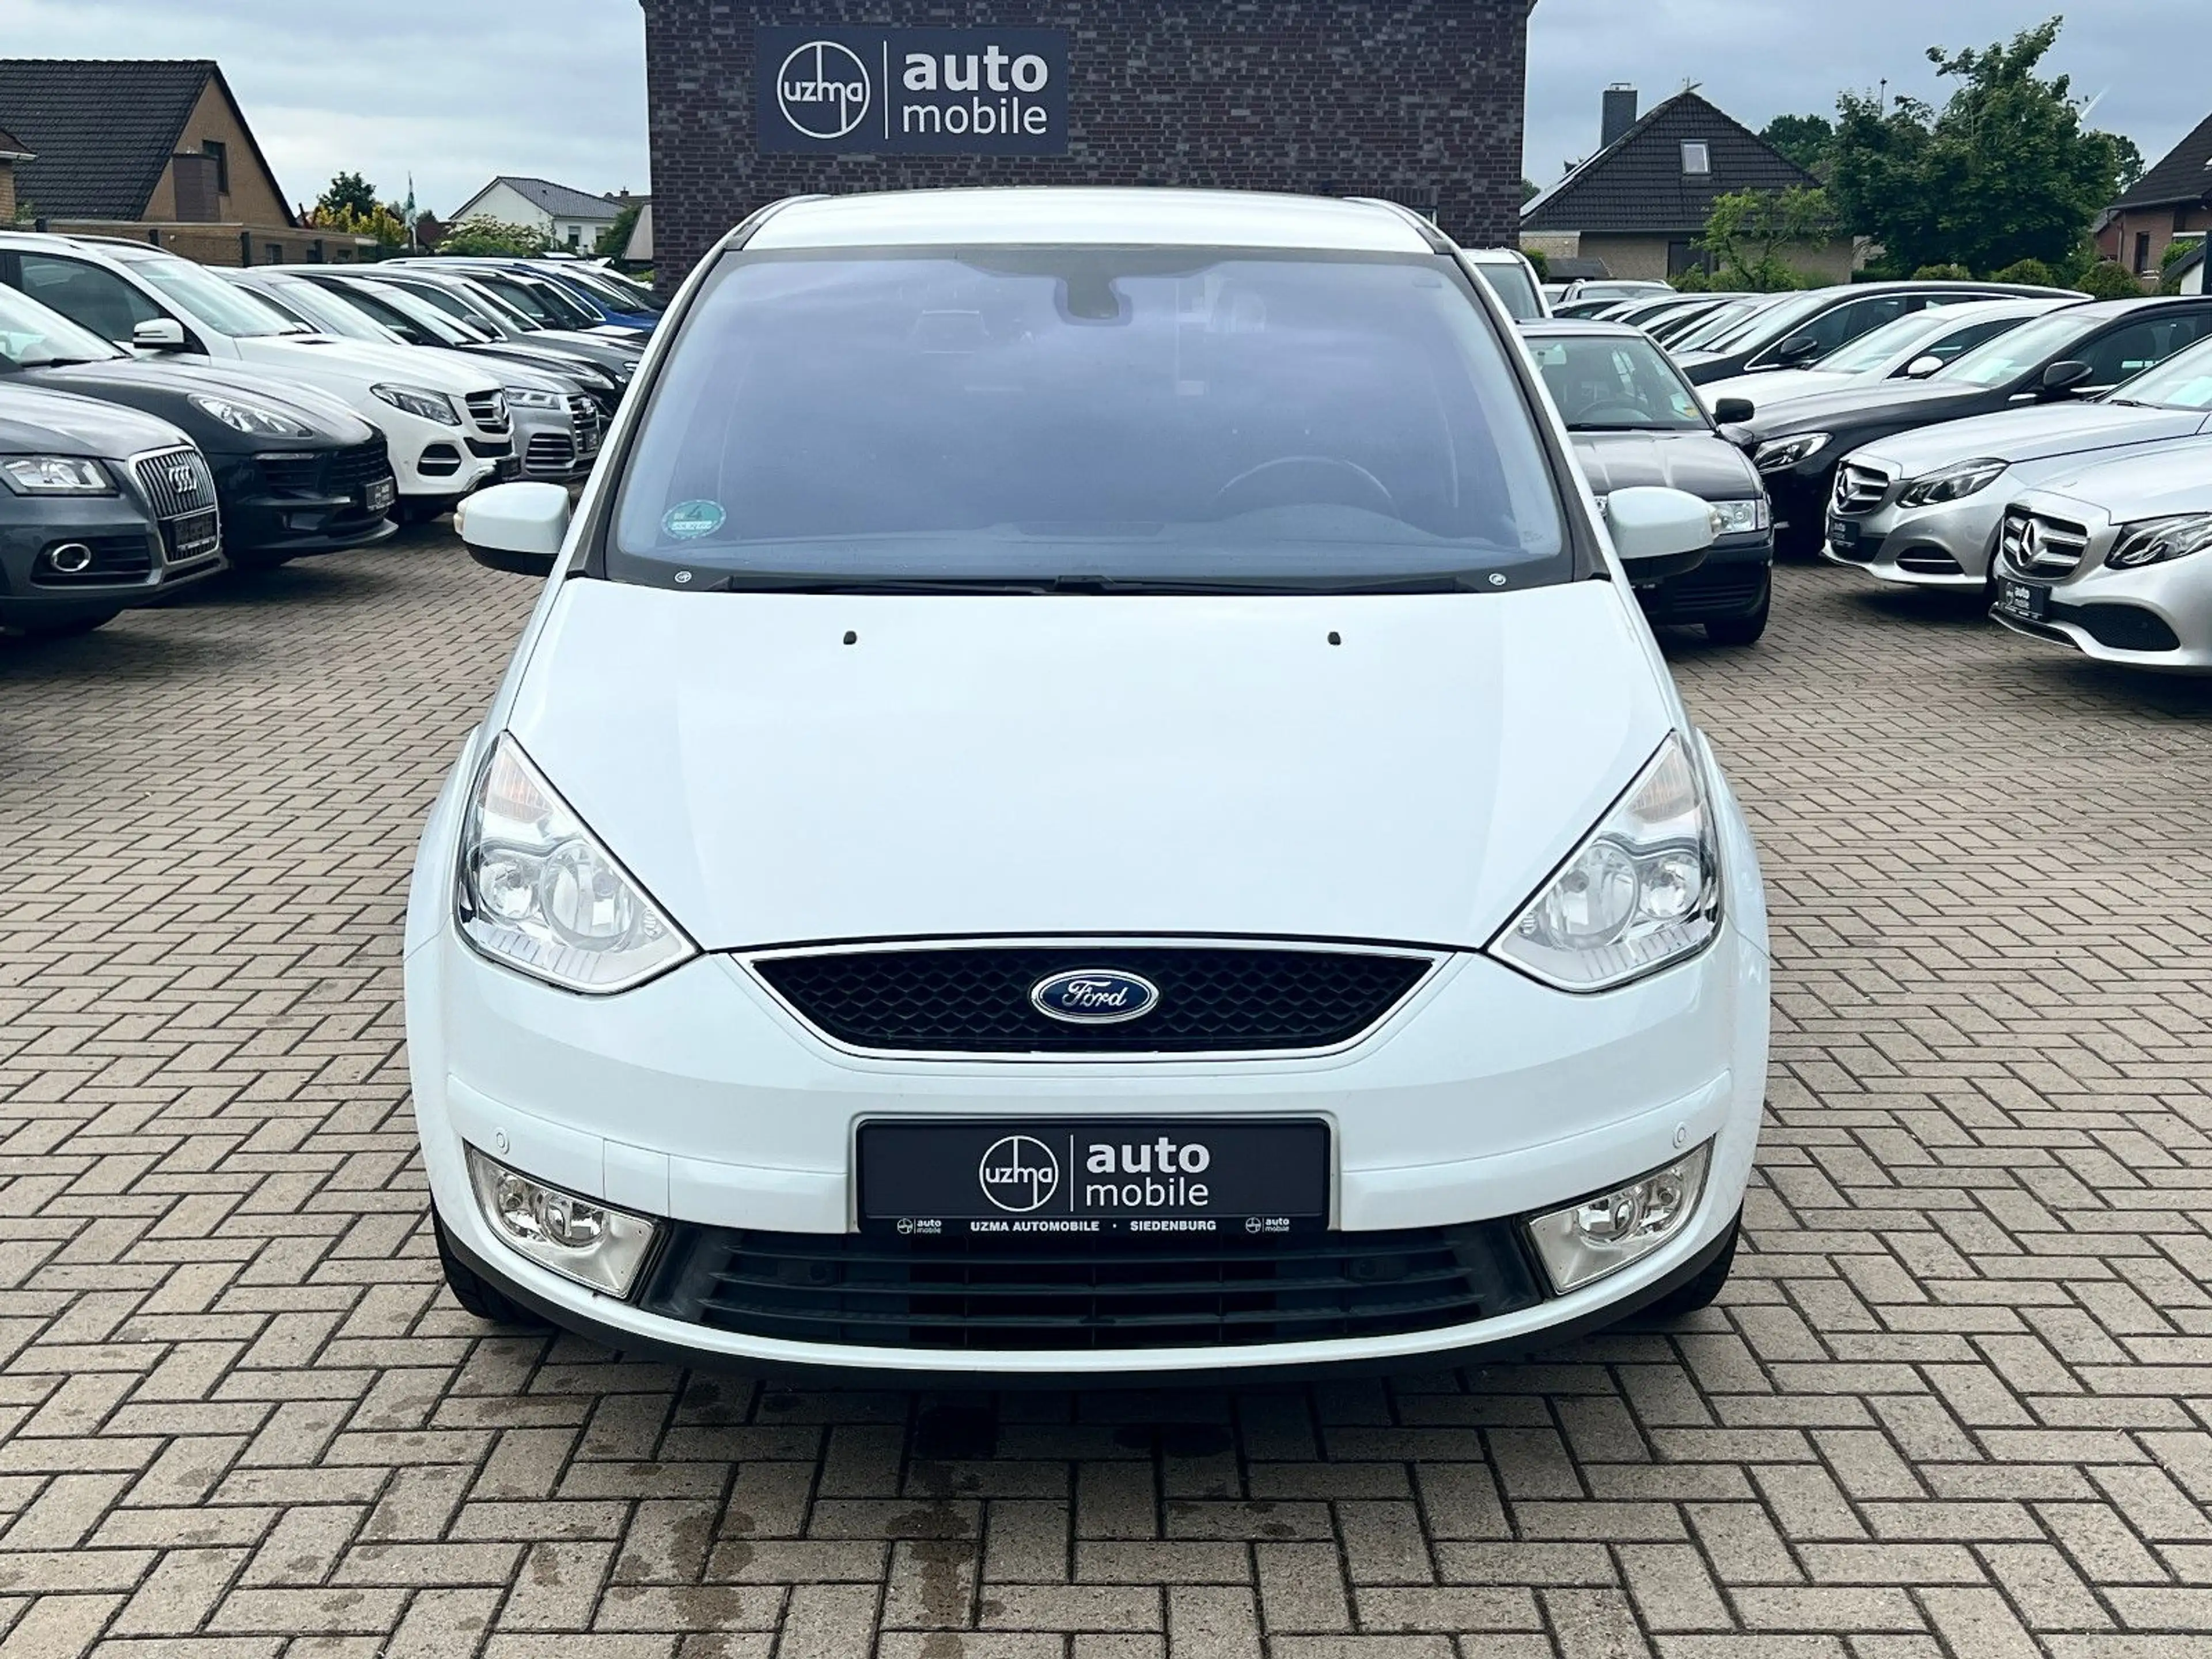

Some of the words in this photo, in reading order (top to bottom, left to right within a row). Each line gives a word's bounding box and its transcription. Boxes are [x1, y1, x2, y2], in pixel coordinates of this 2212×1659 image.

[902, 45, 1048, 93] auto
[902, 96, 1048, 134] mobile
[1062, 980, 1129, 1007] Ford
[1086, 1137, 1210, 1173] auto
[1086, 1177, 1209, 1206] mobile
[916, 1219, 942, 1227] auto
[970, 1221, 1009, 1232] UZMA
[1012, 1221, 1100, 1232] AUTOMOBILE
[1129, 1221, 1217, 1231] SIEDENBURG
[1265, 1217, 1290, 1226] auto
